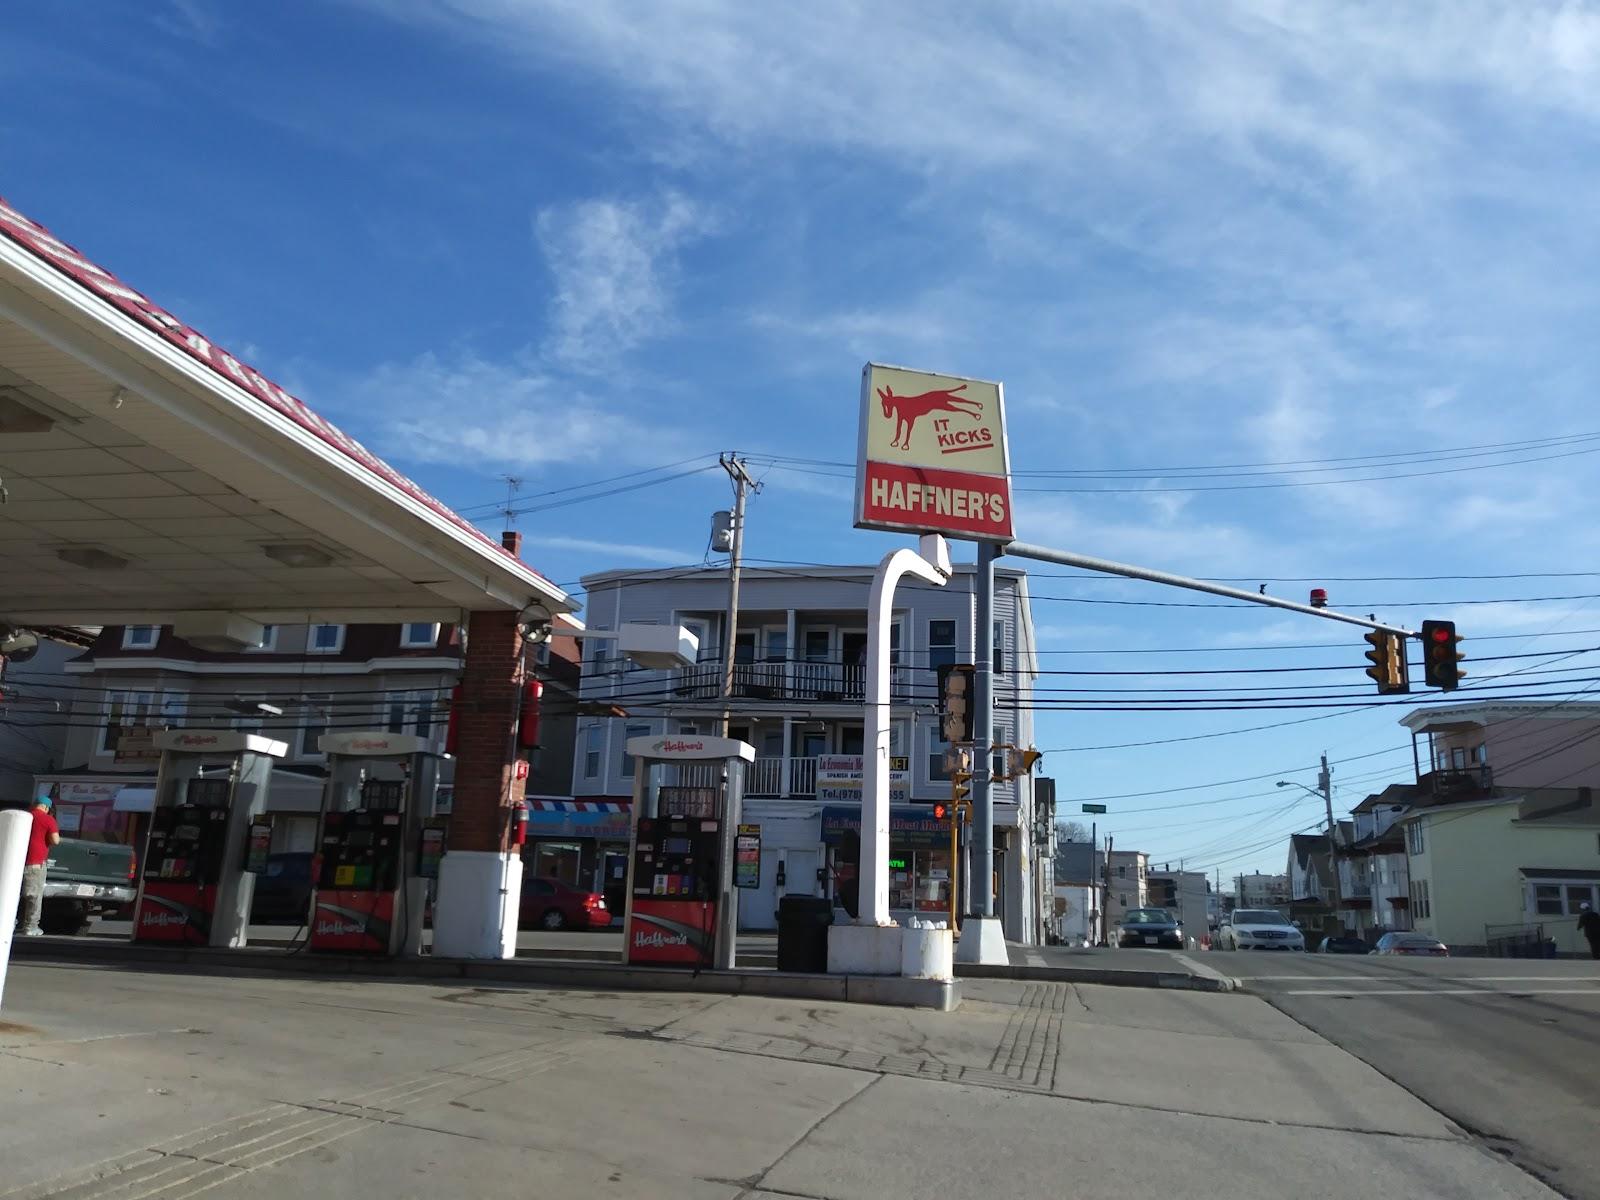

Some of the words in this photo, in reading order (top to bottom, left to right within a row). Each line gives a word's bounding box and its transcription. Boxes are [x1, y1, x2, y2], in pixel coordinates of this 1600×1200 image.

[934, 419, 950, 432] IT
[937, 428, 992, 447] KICKS
[871, 478, 1005, 523] HAFFNER'S
[663, 739, 704, 752] Haffner's
[819, 757, 827, 770] La
[855, 758, 863, 771] Me
[889, 758, 908, 770] KET
[822, 789, 862, 800] Tel.(978)
[889, 860, 905, 868] ATM
[635, 931, 687, 947] Haffner's
